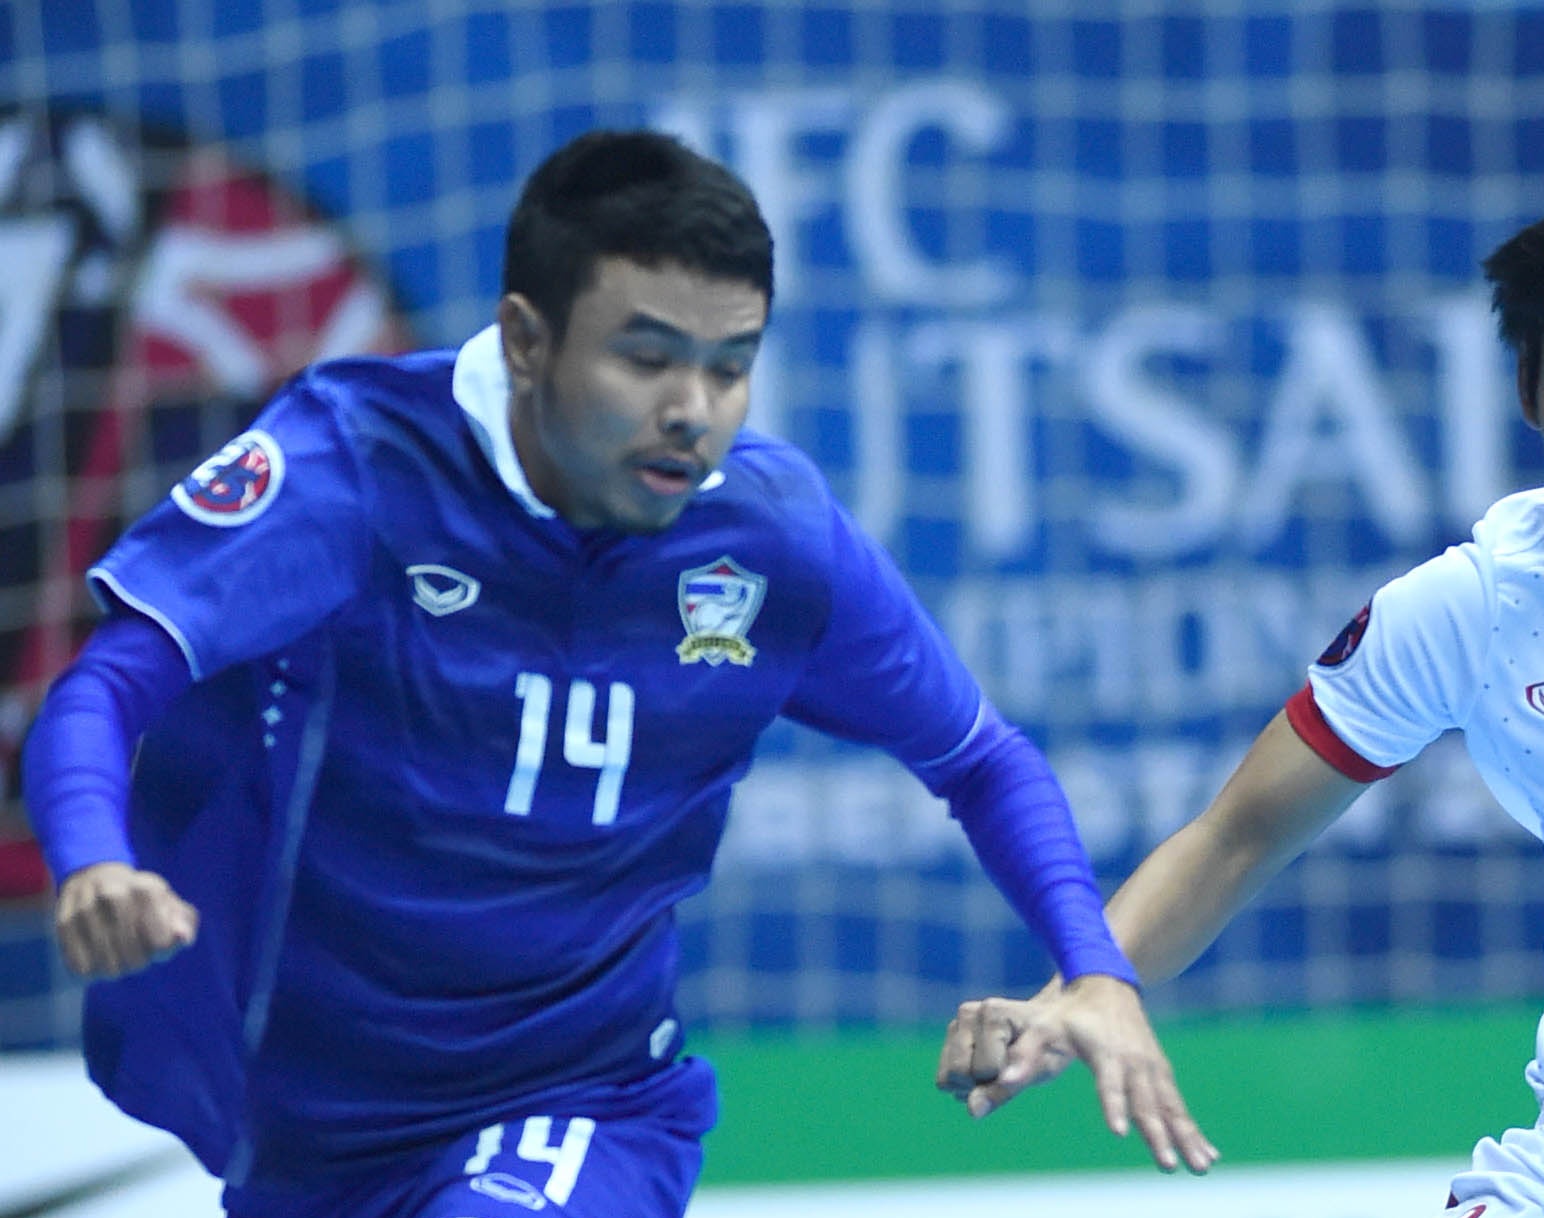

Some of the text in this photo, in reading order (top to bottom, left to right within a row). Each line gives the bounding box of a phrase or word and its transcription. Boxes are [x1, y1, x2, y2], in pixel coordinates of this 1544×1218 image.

[645, 84, 1012, 302] FC
[504, 672, 635, 826] 14
[463, 1115, 596, 1207] 14
